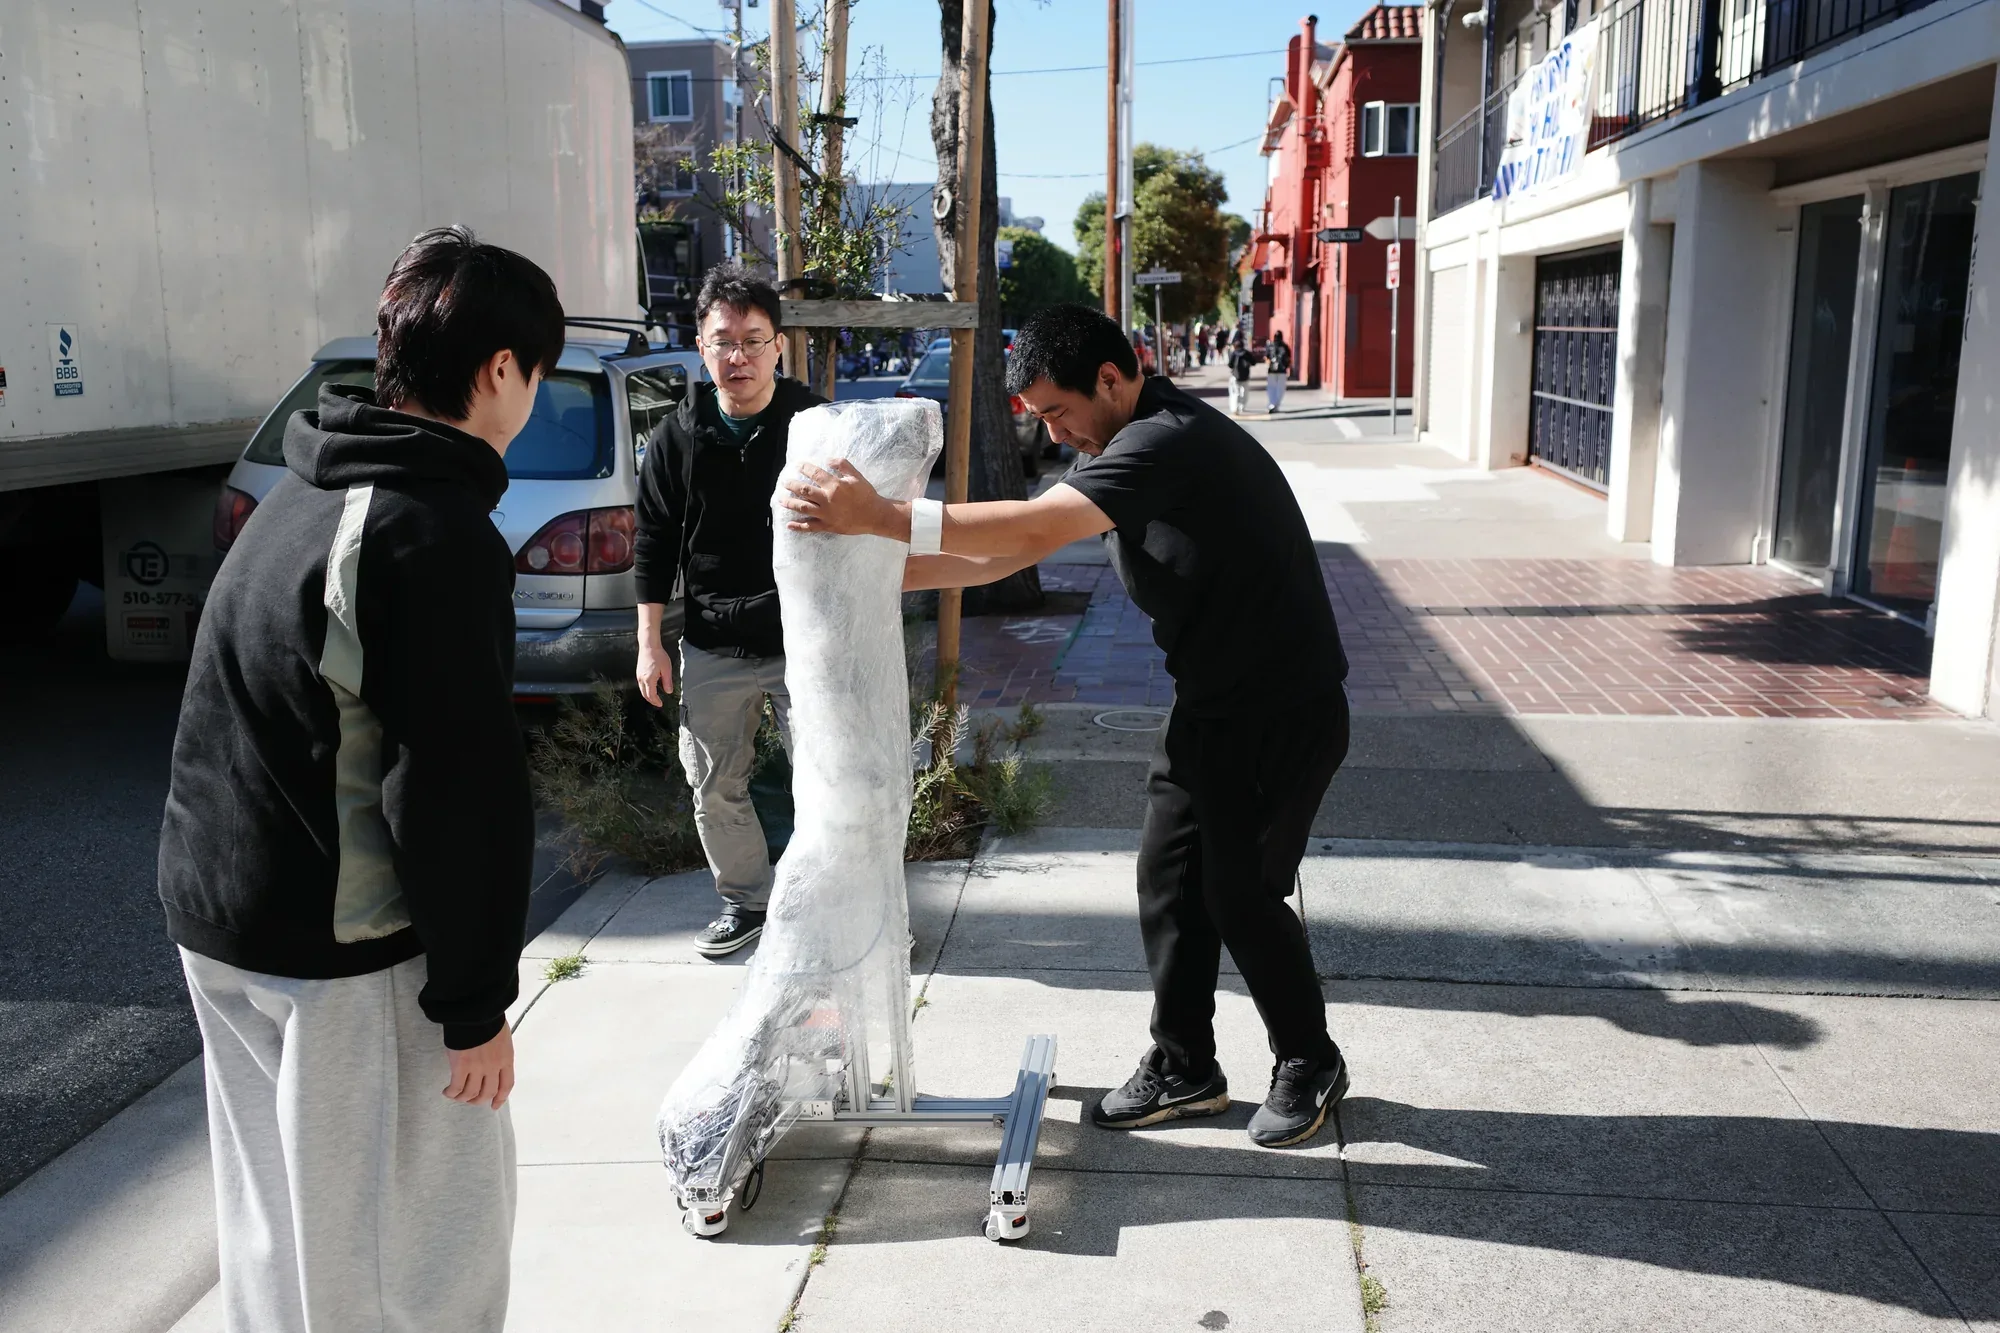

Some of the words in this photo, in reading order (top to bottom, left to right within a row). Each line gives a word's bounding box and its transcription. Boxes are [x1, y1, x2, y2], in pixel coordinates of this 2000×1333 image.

[56, 366, 78, 380] BBB
[56, 382, 81, 390] ACCREDITED
[123, 591, 195, 606] 510-577-5
[537, 591, 574, 600] 300
